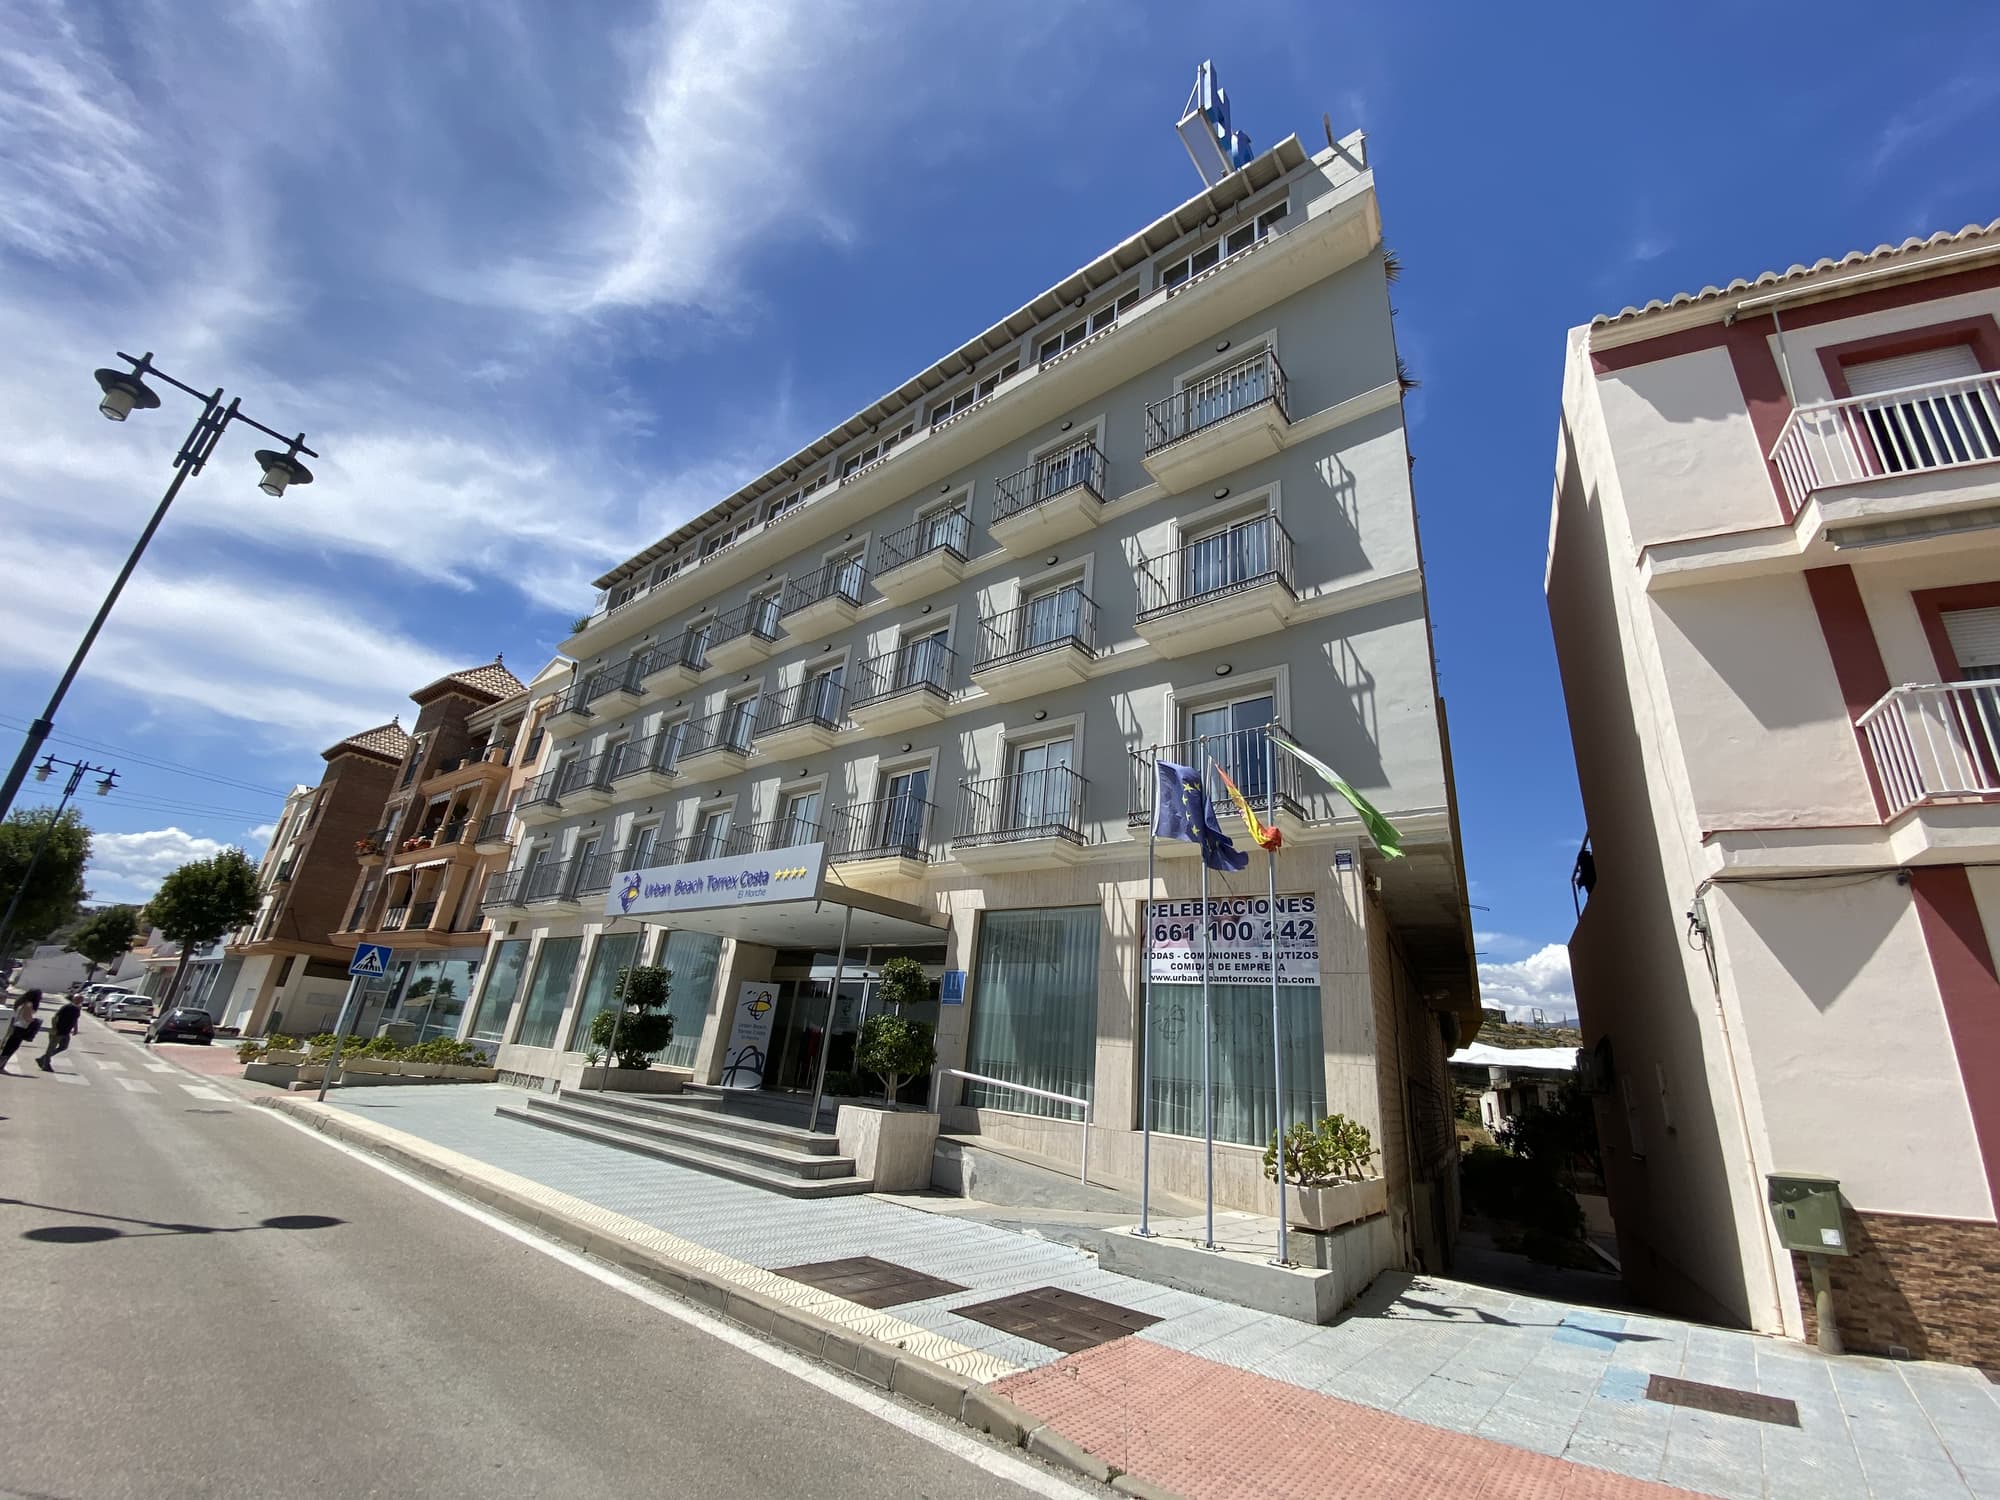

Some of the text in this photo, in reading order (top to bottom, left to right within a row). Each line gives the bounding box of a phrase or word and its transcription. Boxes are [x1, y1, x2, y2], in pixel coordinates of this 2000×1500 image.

[644, 882, 671, 899] Urban
[674, 877, 703, 896] Beach
[740, 870, 769, 888] Costa
[1145, 897, 1315, 918] CELEBRACIONES
[1155, 919, 1315, 942] 661 100 242
[1218, 963, 1231, 971] DE
[1234, 963, 1286, 972] EMPREA
